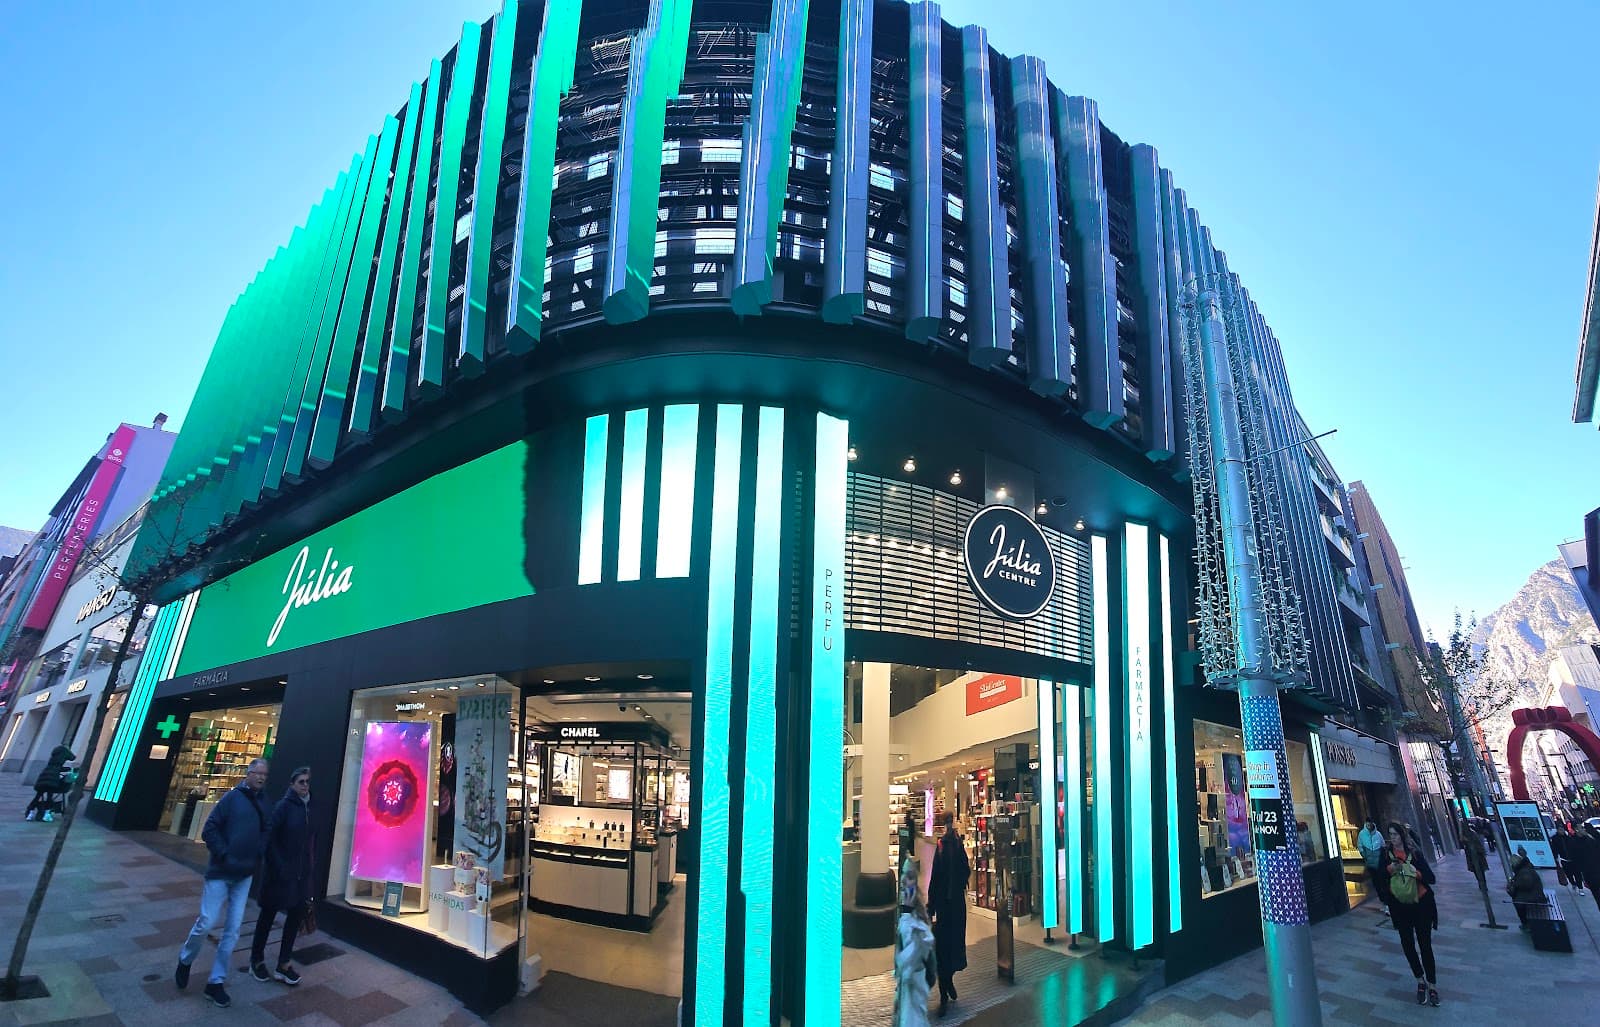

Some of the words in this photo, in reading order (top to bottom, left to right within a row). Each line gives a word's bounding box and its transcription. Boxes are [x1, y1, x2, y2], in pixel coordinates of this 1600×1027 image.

[983, 524, 1042, 579] Júlia
[999, 570, 1036, 587] CENTRE
[266, 545, 354, 648] Júlia
[823, 568, 833, 651] PERFU
[560, 727, 601, 737] CHANEL
[1263, 811, 1278, 823] 23
[1259, 825, 1279, 835] NOV.
